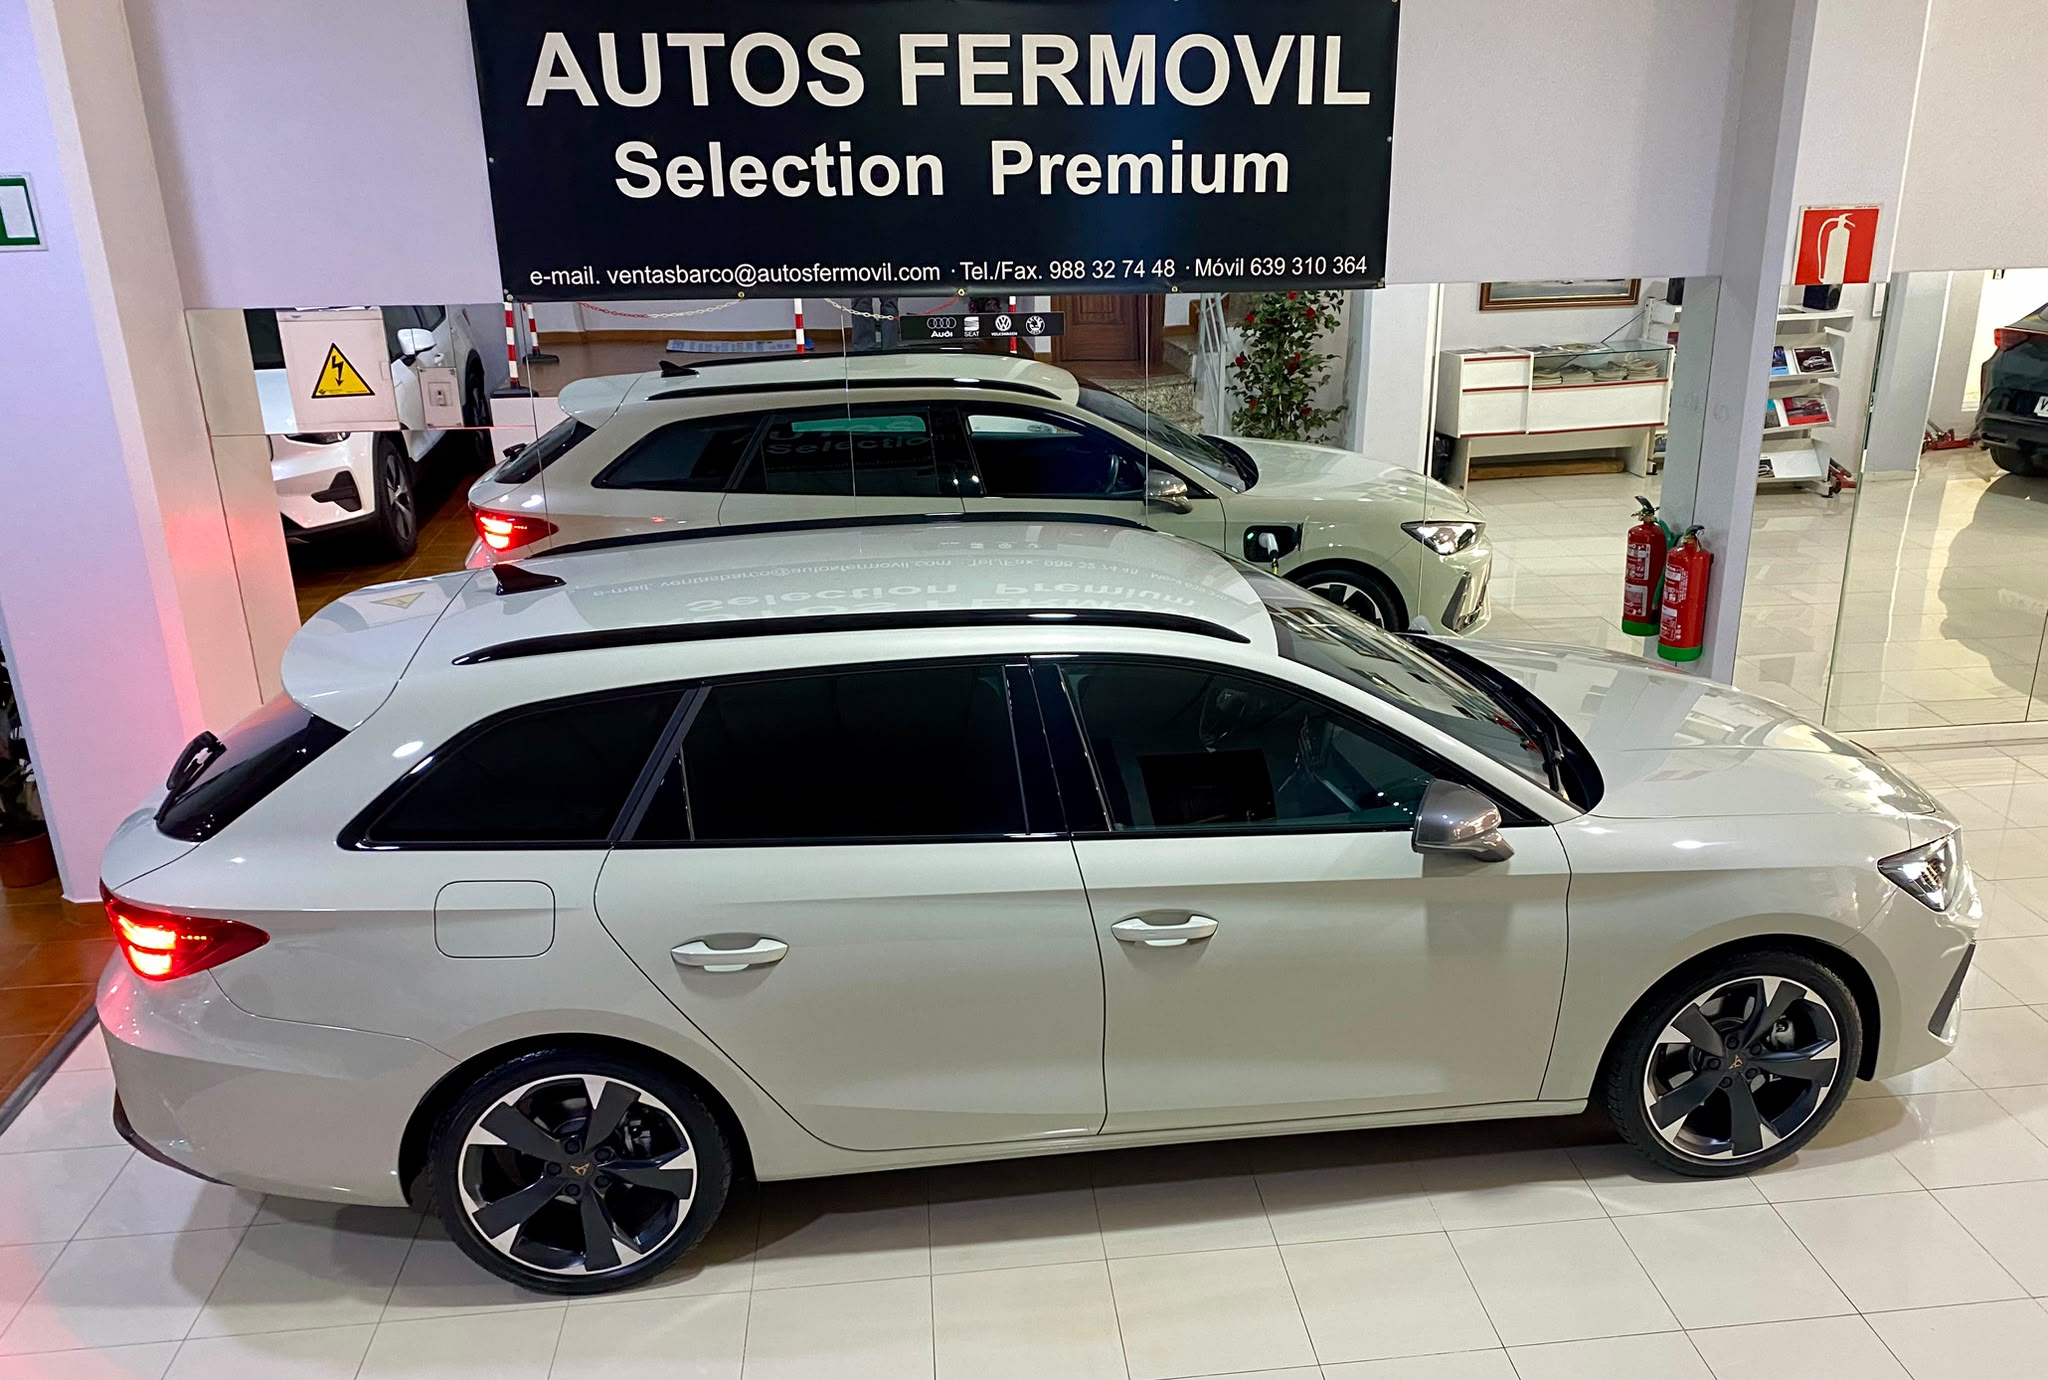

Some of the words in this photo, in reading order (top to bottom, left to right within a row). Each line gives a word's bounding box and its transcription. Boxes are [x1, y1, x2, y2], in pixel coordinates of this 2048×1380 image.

[526, 31, 865, 108] AUTOS
[899, 33, 1371, 107] FERMOVIL
[615, 140, 944, 199] Selection
[991, 139, 1289, 196] Premium
[529, 265, 600, 286] e-mail.
[606, 262, 941, 288] ventasbarco@autosfermovil.com
[1049, 260, 1086, 280] 988
[1092, 259, 1116, 279] 32
[1121, 259, 1146, 279] 74
[1150, 258, 1176, 278] 48
[1250, 256, 1286, 276] 639
[1291, 256, 1327, 276] 310
[1332, 255, 1367, 275] 364
[964, 330, 980, 338] SEAT
